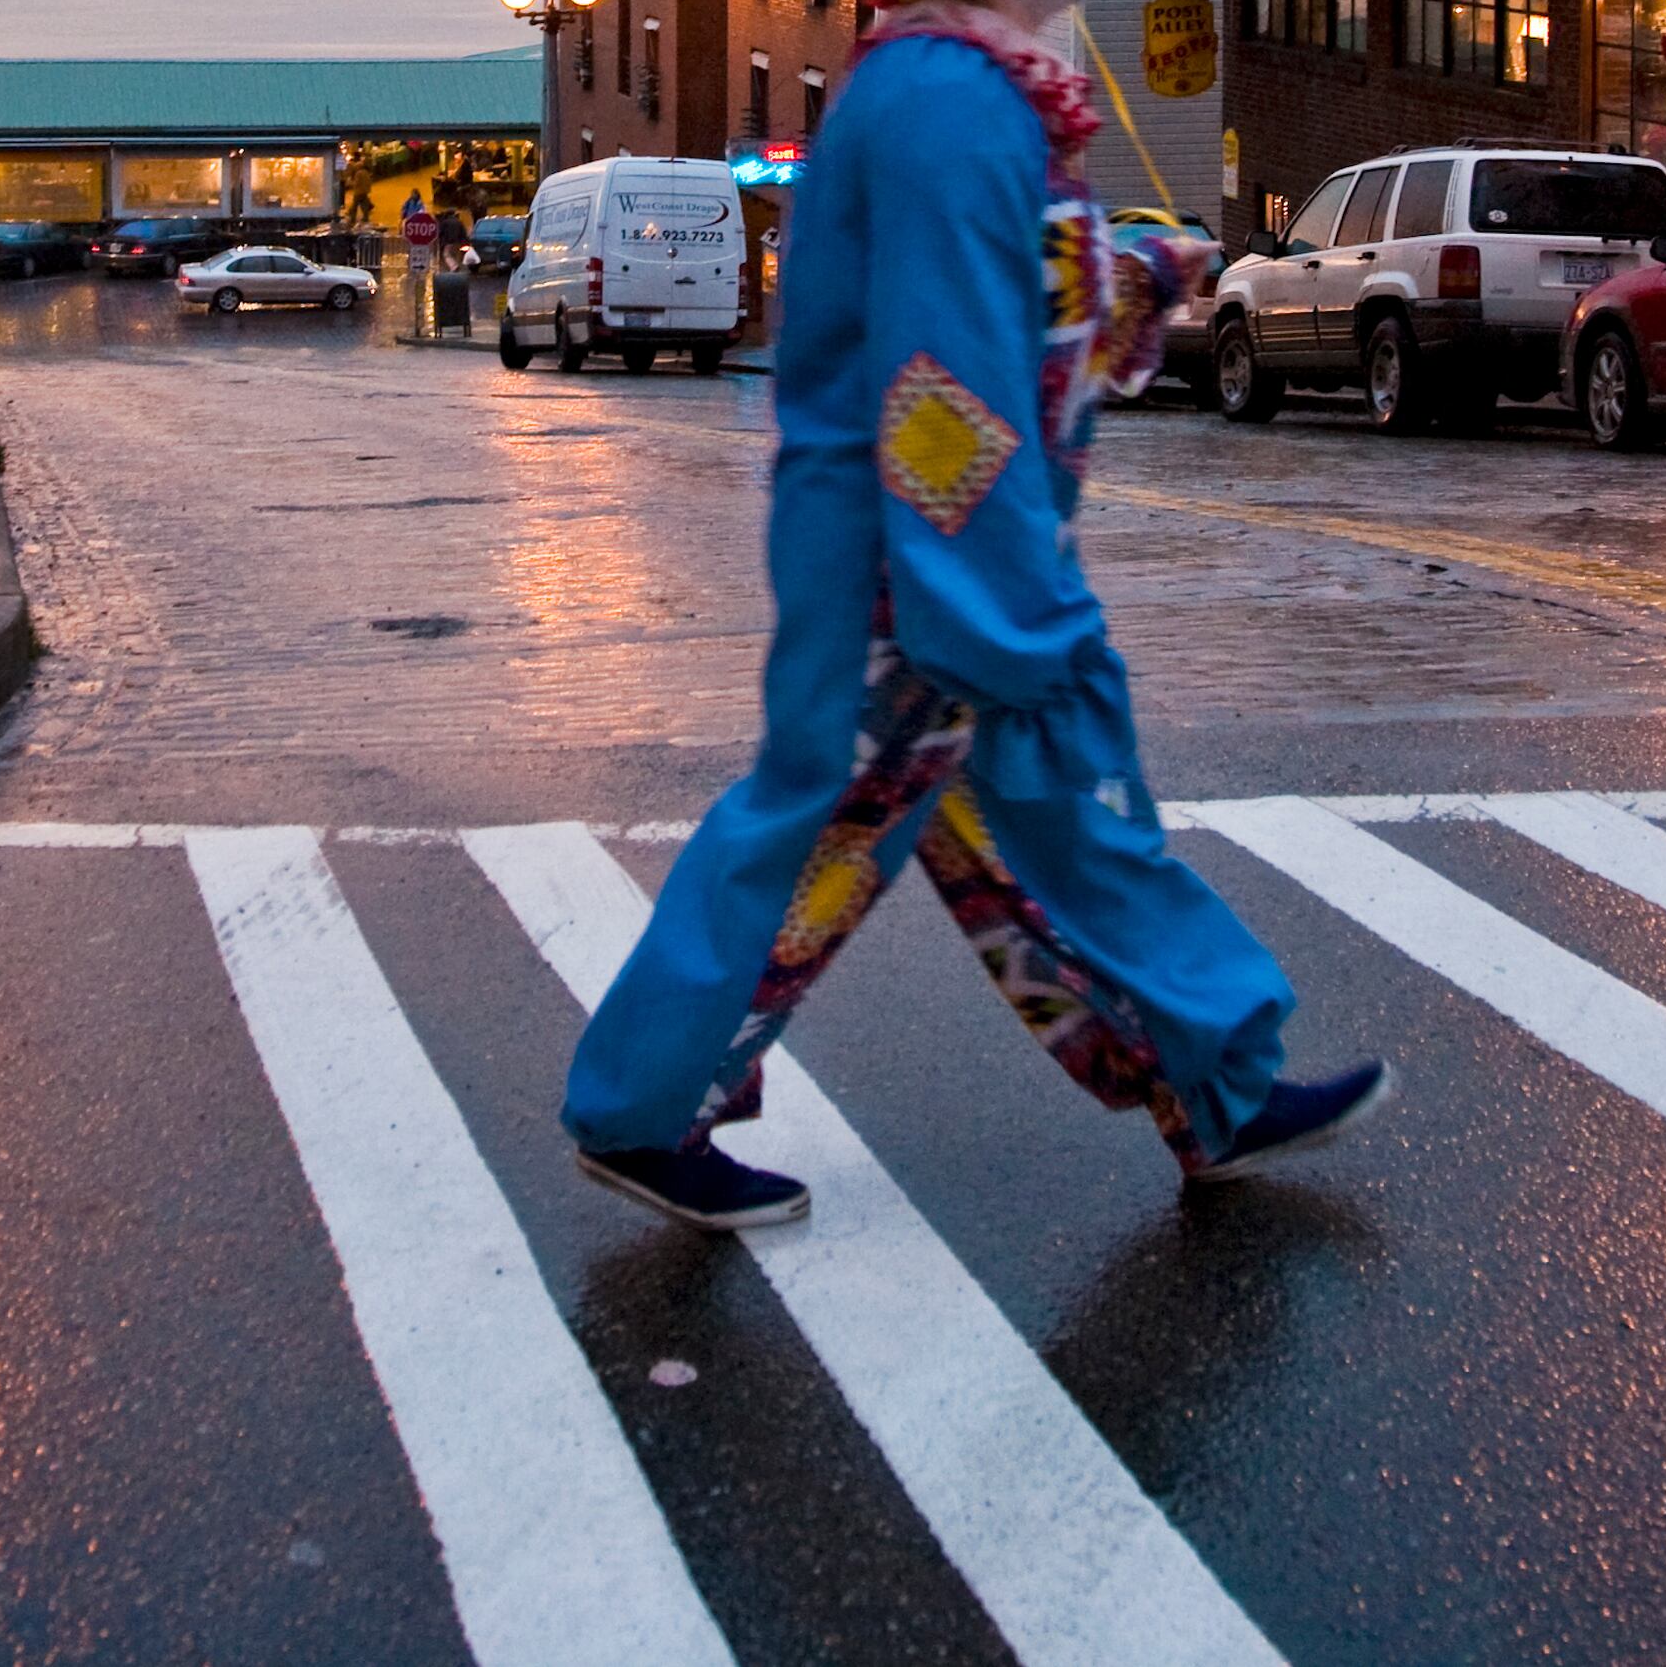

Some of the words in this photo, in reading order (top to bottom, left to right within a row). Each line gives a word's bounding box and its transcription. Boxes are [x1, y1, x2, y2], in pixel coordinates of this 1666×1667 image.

[1154, 5, 1203, 20] POST
[1152, 19, 1207, 34] ALLEY
[406, 222, 436, 236] STOP
